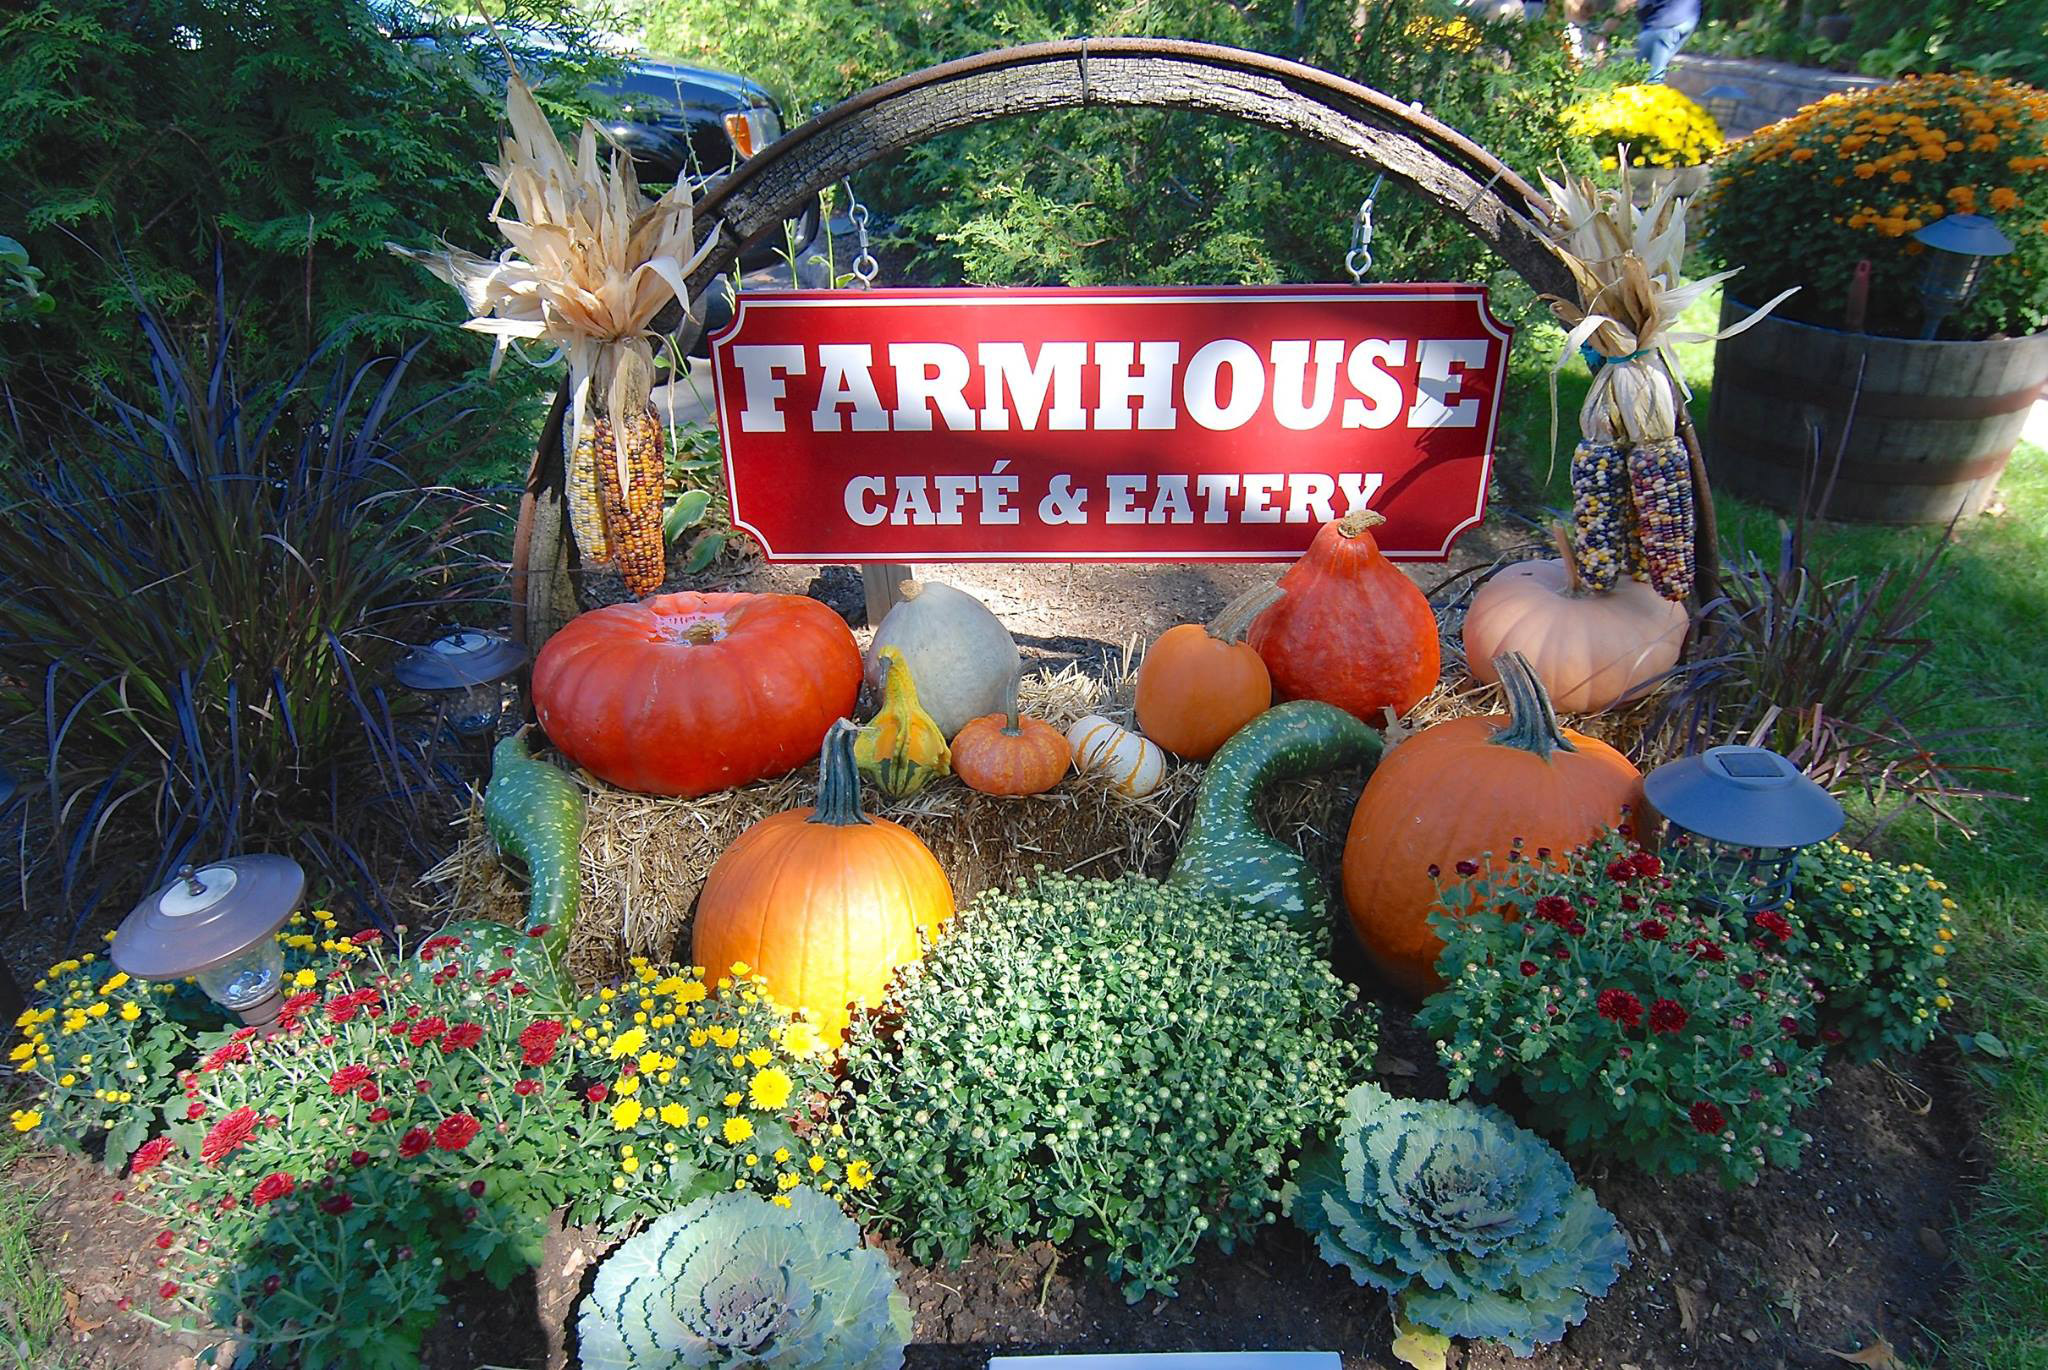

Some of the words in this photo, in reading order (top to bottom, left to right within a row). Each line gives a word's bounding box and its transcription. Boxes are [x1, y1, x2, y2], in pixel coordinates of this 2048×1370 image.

[733, 339, 1489, 432] FARMHOUSE
[844, 460, 1020, 526] CAFÉ
[1038, 474, 1088, 525] &
[1106, 473, 1383, 525] EATERY
